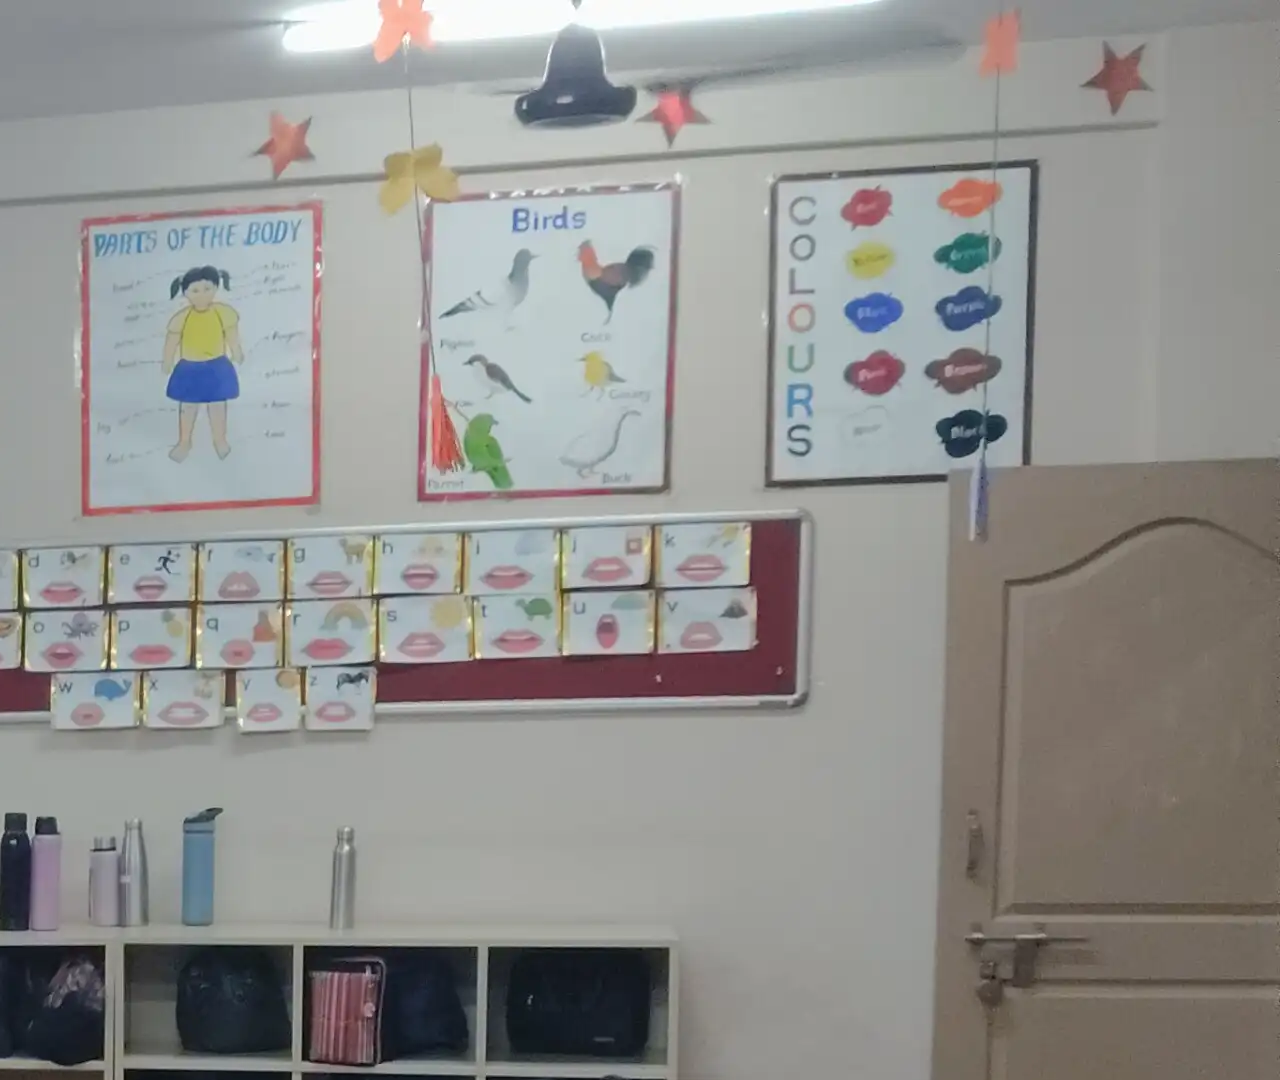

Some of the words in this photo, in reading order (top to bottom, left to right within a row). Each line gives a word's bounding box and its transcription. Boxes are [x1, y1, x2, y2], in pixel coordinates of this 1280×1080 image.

[512, 205, 587, 233] Birds
[93, 230, 157, 258] PARTS
[167, 227, 192, 251] OF
[198, 223, 239, 249] THE
[243, 218, 302, 246] BODY
[787, 196, 817, 457] COLOURS
[665, 533, 675, 547] k
[382, 540, 394, 555] h
[28, 554, 40, 568] d
[119, 554, 130, 565] e
[293, 547, 306, 563] g
[573, 602, 586, 615] u
[667, 602, 678, 612] v
[293, 612, 301, 626] r
[386, 610, 397, 622] s
[118, 620, 130, 633] p
[206, 617, 218, 631] q
[58, 681, 73, 694] w
